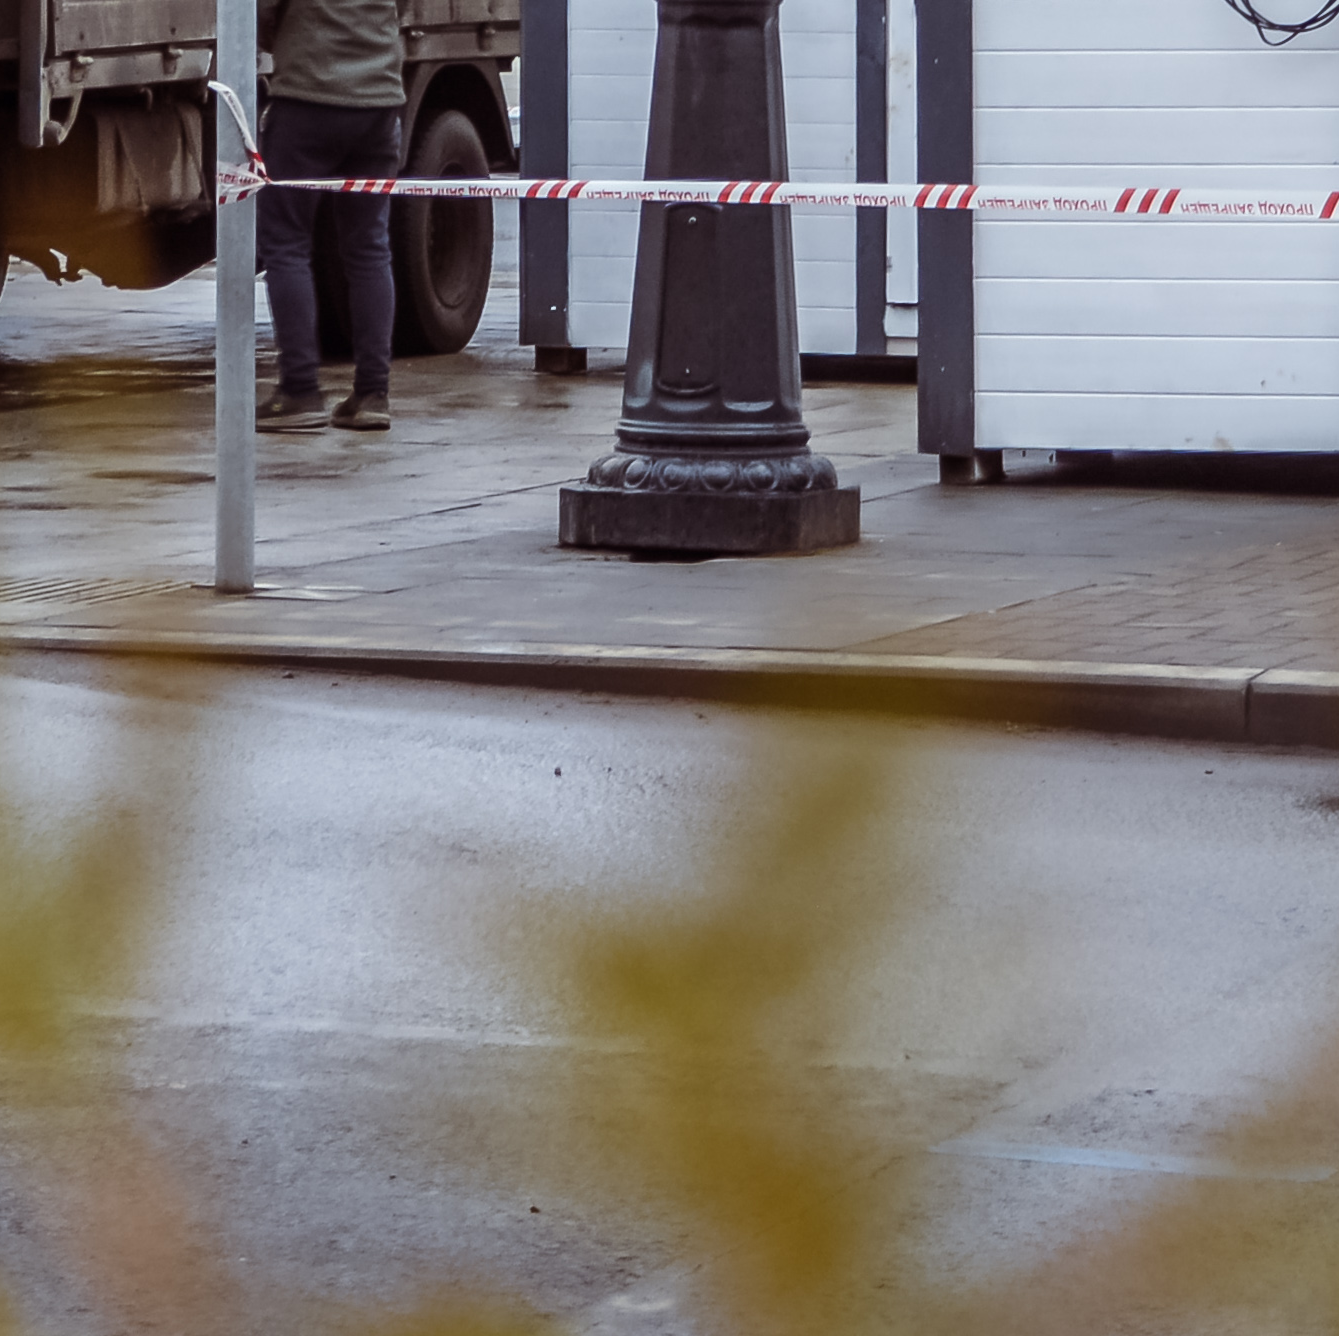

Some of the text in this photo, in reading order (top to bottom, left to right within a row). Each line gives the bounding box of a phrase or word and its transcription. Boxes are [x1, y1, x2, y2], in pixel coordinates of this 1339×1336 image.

[977, 197, 1108, 211] ПРОХОД ЗАПРЕЩЕН
[1180, 200, 1314, 215] ПРОХОД ЗАПРЕЩЕН
